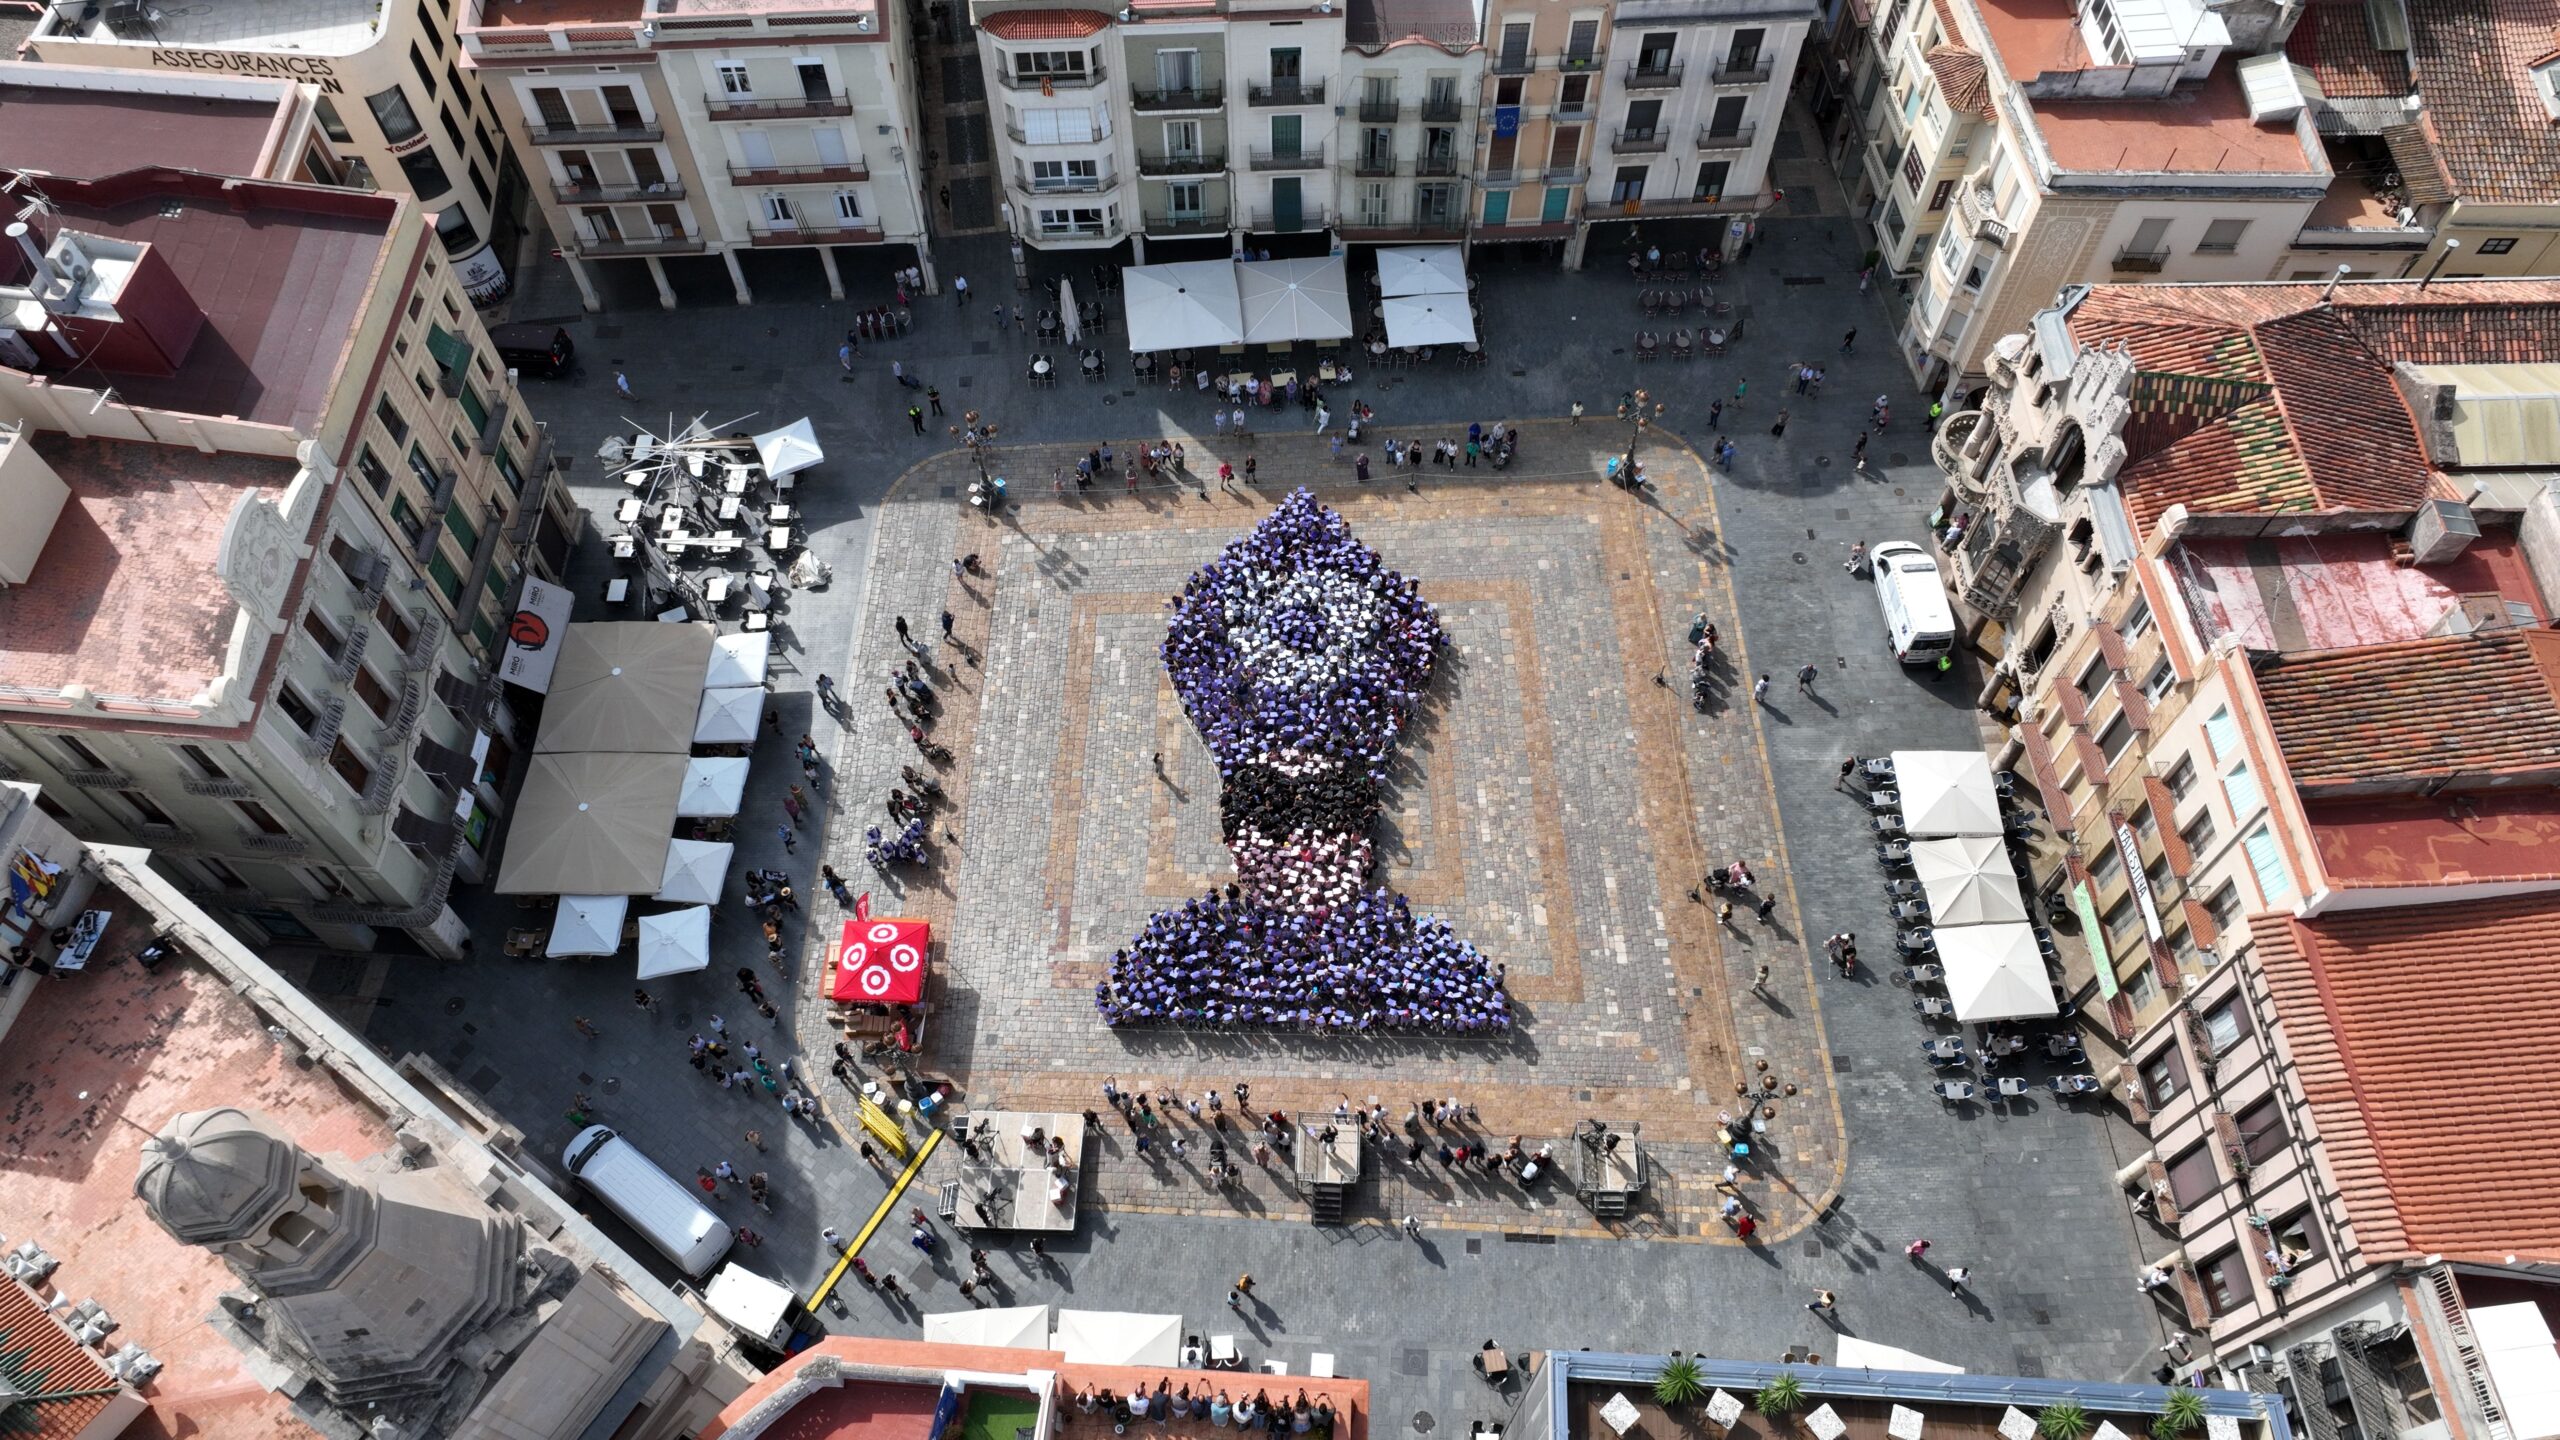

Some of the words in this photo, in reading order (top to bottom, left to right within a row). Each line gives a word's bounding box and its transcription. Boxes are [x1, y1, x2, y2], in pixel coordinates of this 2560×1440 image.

[152, 50, 334, 76] ASSEGURANCES
[395, 133, 428, 153] Occident
[529, 585, 540, 605] MIRÓ
[509, 655, 520, 675] MIRÓ
[2120, 828, 2148, 900] PALESTINA
